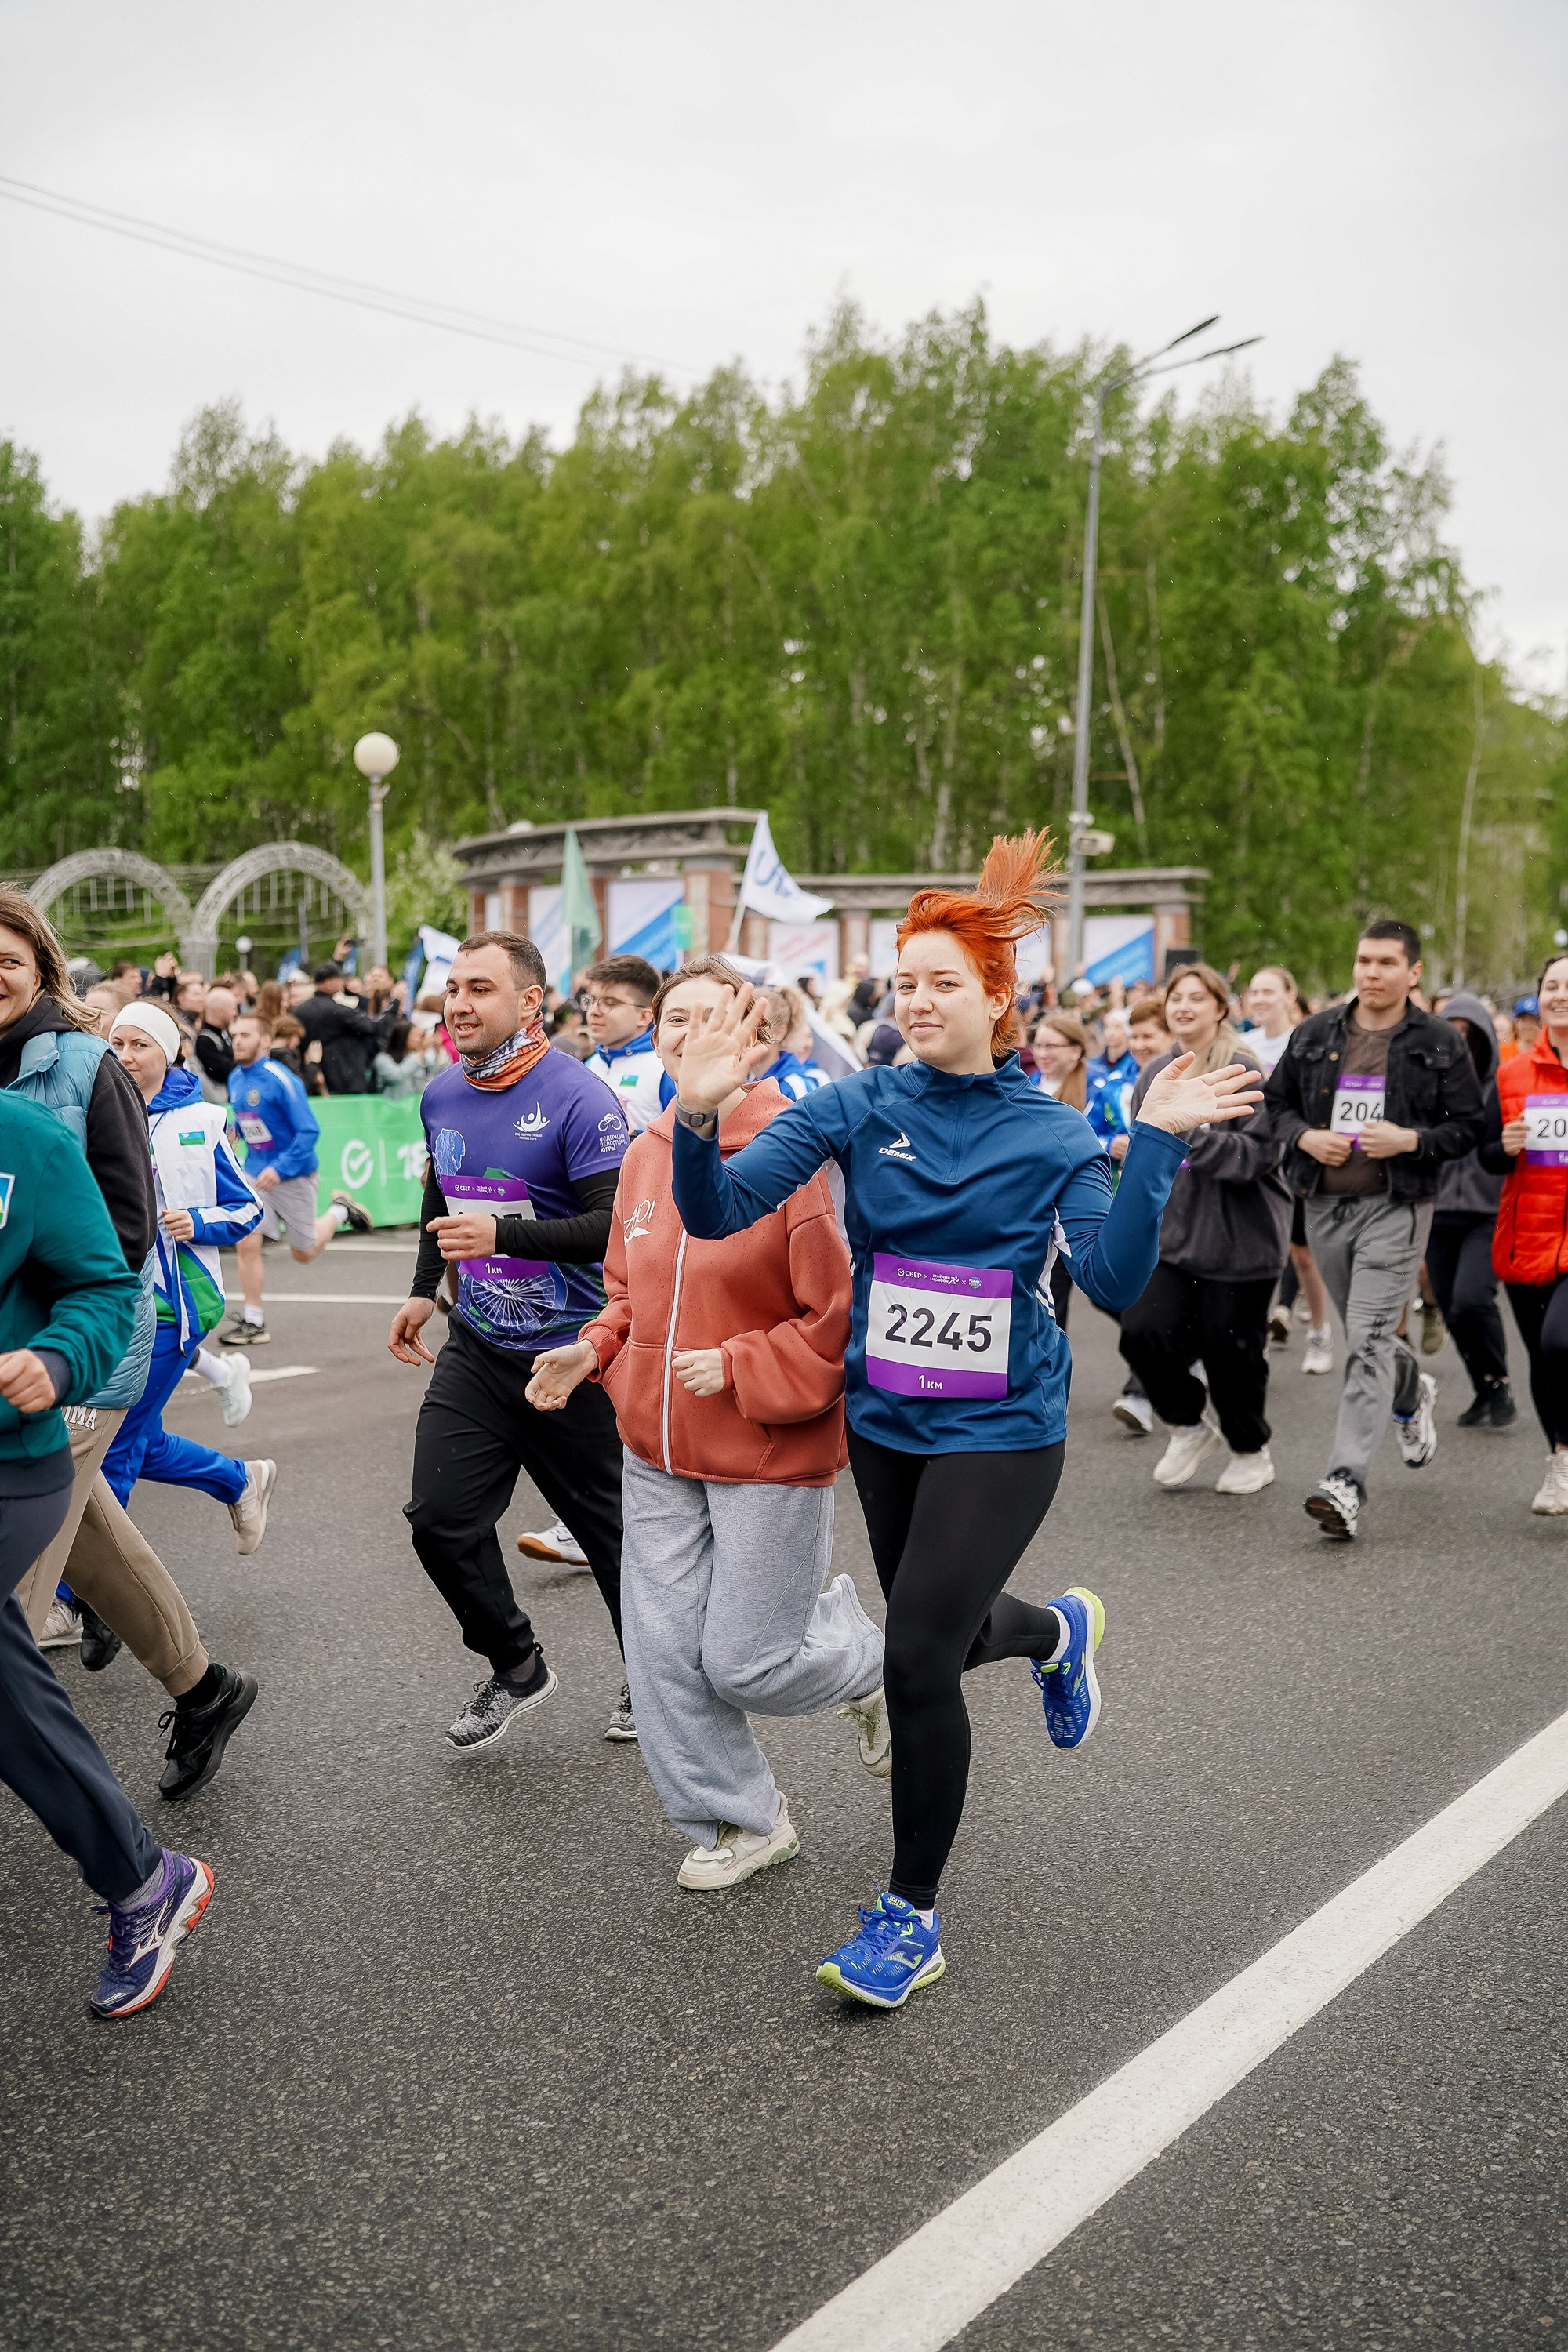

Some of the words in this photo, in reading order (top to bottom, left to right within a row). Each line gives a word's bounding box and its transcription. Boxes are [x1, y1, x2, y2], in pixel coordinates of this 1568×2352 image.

[878, 1147, 916, 1162] DEMIX
[905, 1270, 923, 1279] СБЕР
[884, 1303, 993, 1352] 2245
